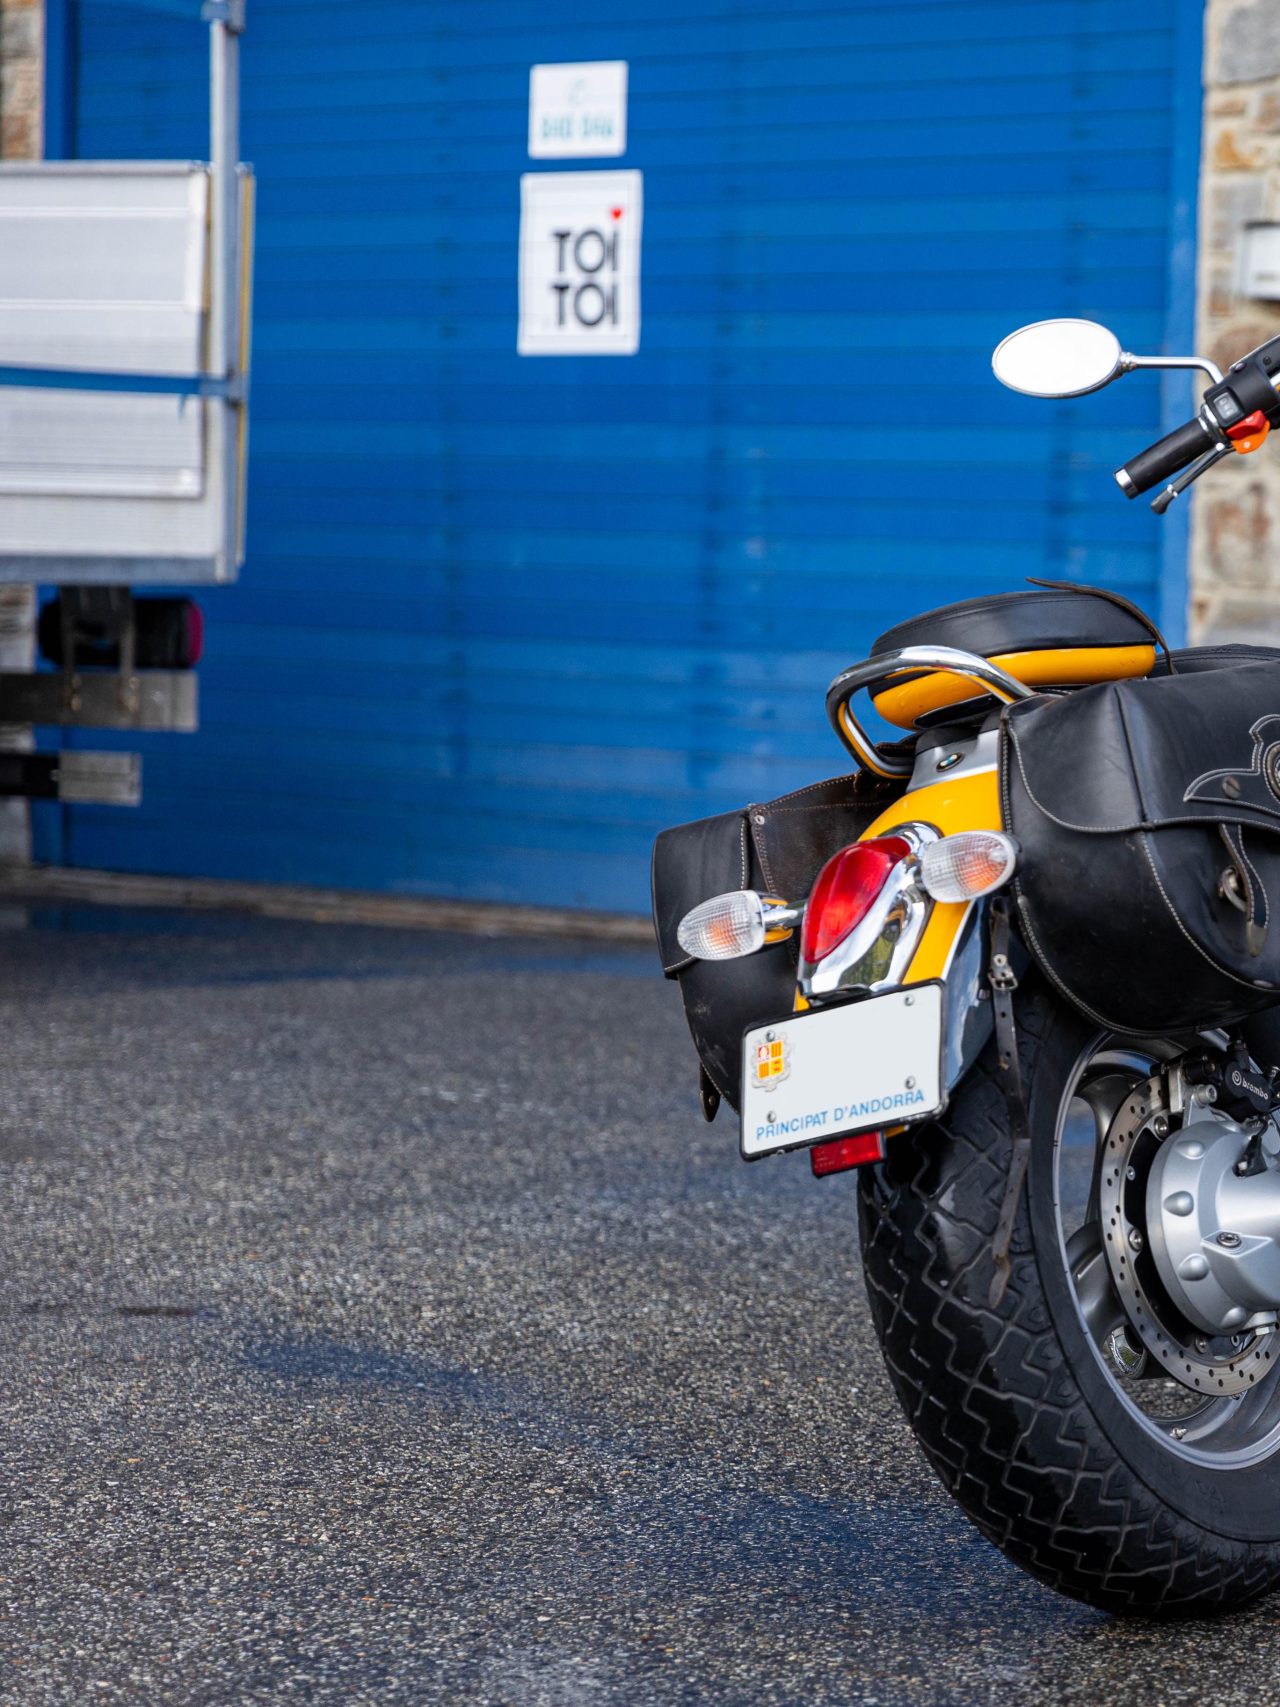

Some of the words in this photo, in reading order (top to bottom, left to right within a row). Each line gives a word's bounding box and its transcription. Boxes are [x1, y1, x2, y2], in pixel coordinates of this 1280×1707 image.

[551, 282, 619, 327] TOI
[1242, 1077, 1268, 1100] brembo
[756, 1111, 828, 1140] PRINCIPAT
[834, 1089, 925, 1121] D'ANDORRA
